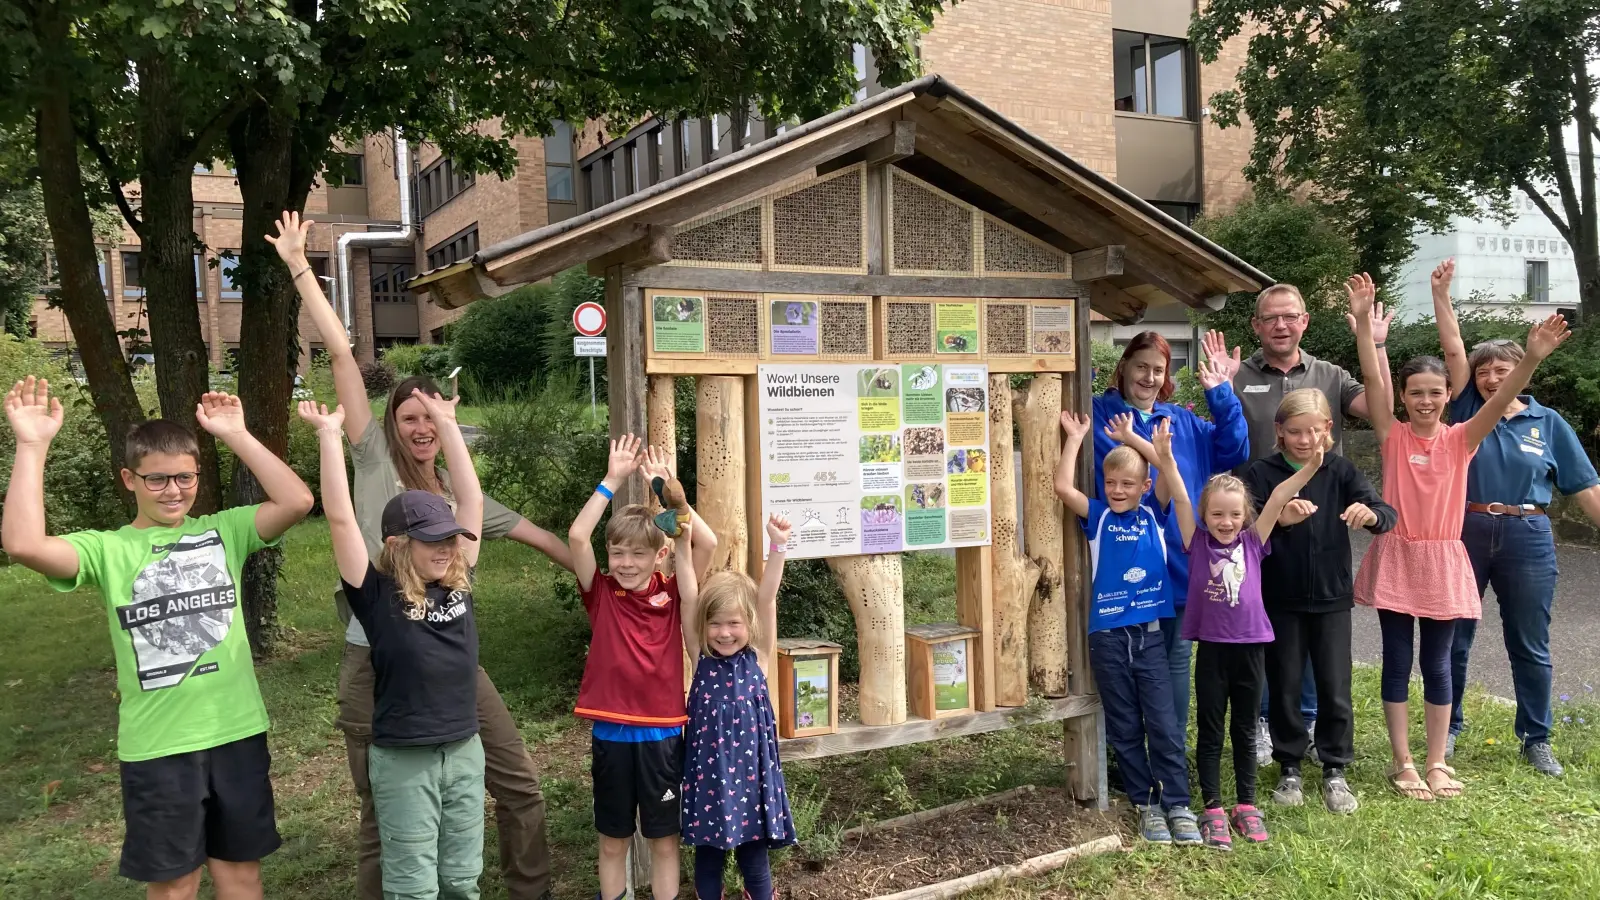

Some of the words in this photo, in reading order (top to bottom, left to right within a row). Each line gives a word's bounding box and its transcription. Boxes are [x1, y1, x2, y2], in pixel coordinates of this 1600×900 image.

[766, 373, 797, 384] Wow!
[800, 373, 840, 384] Unsere
[766, 386, 835, 398] Wildbienen
[125, 603, 161, 624] LOS
[165, 589, 235, 614] ANGELES
